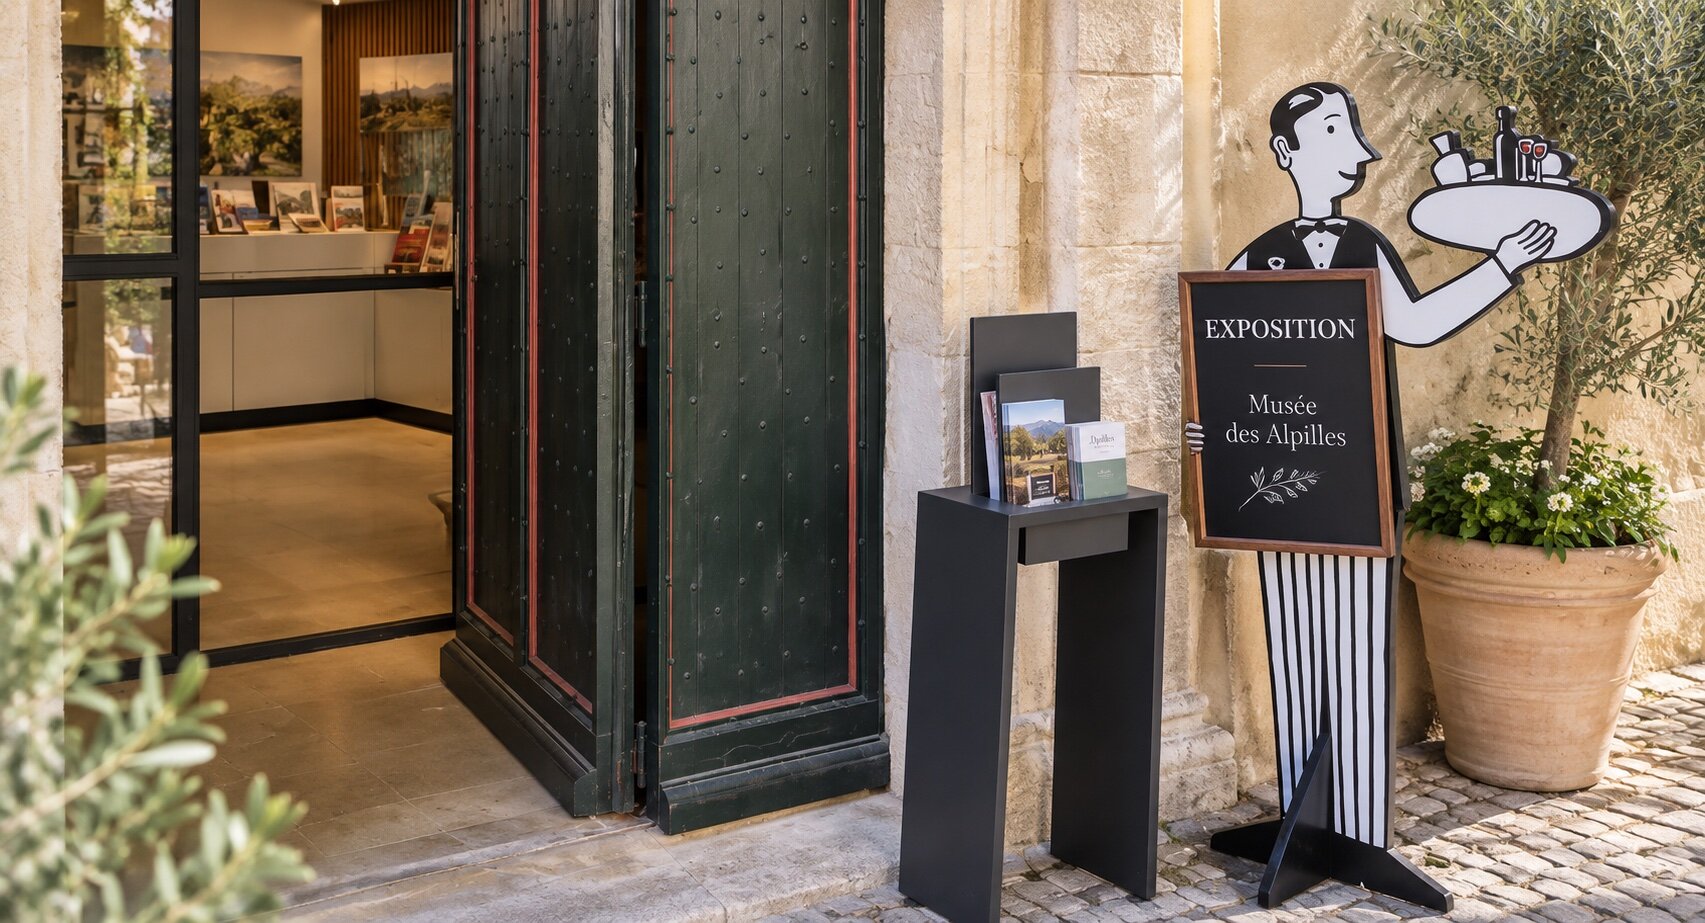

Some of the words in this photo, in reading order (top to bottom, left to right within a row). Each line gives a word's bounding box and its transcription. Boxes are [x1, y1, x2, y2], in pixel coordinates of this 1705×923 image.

[1205, 319, 1355, 339] EXPOSITION
[1249, 394, 1316, 415] Musée
[1226, 422, 1259, 443] des
[1266, 424, 1346, 451] Alpilles
